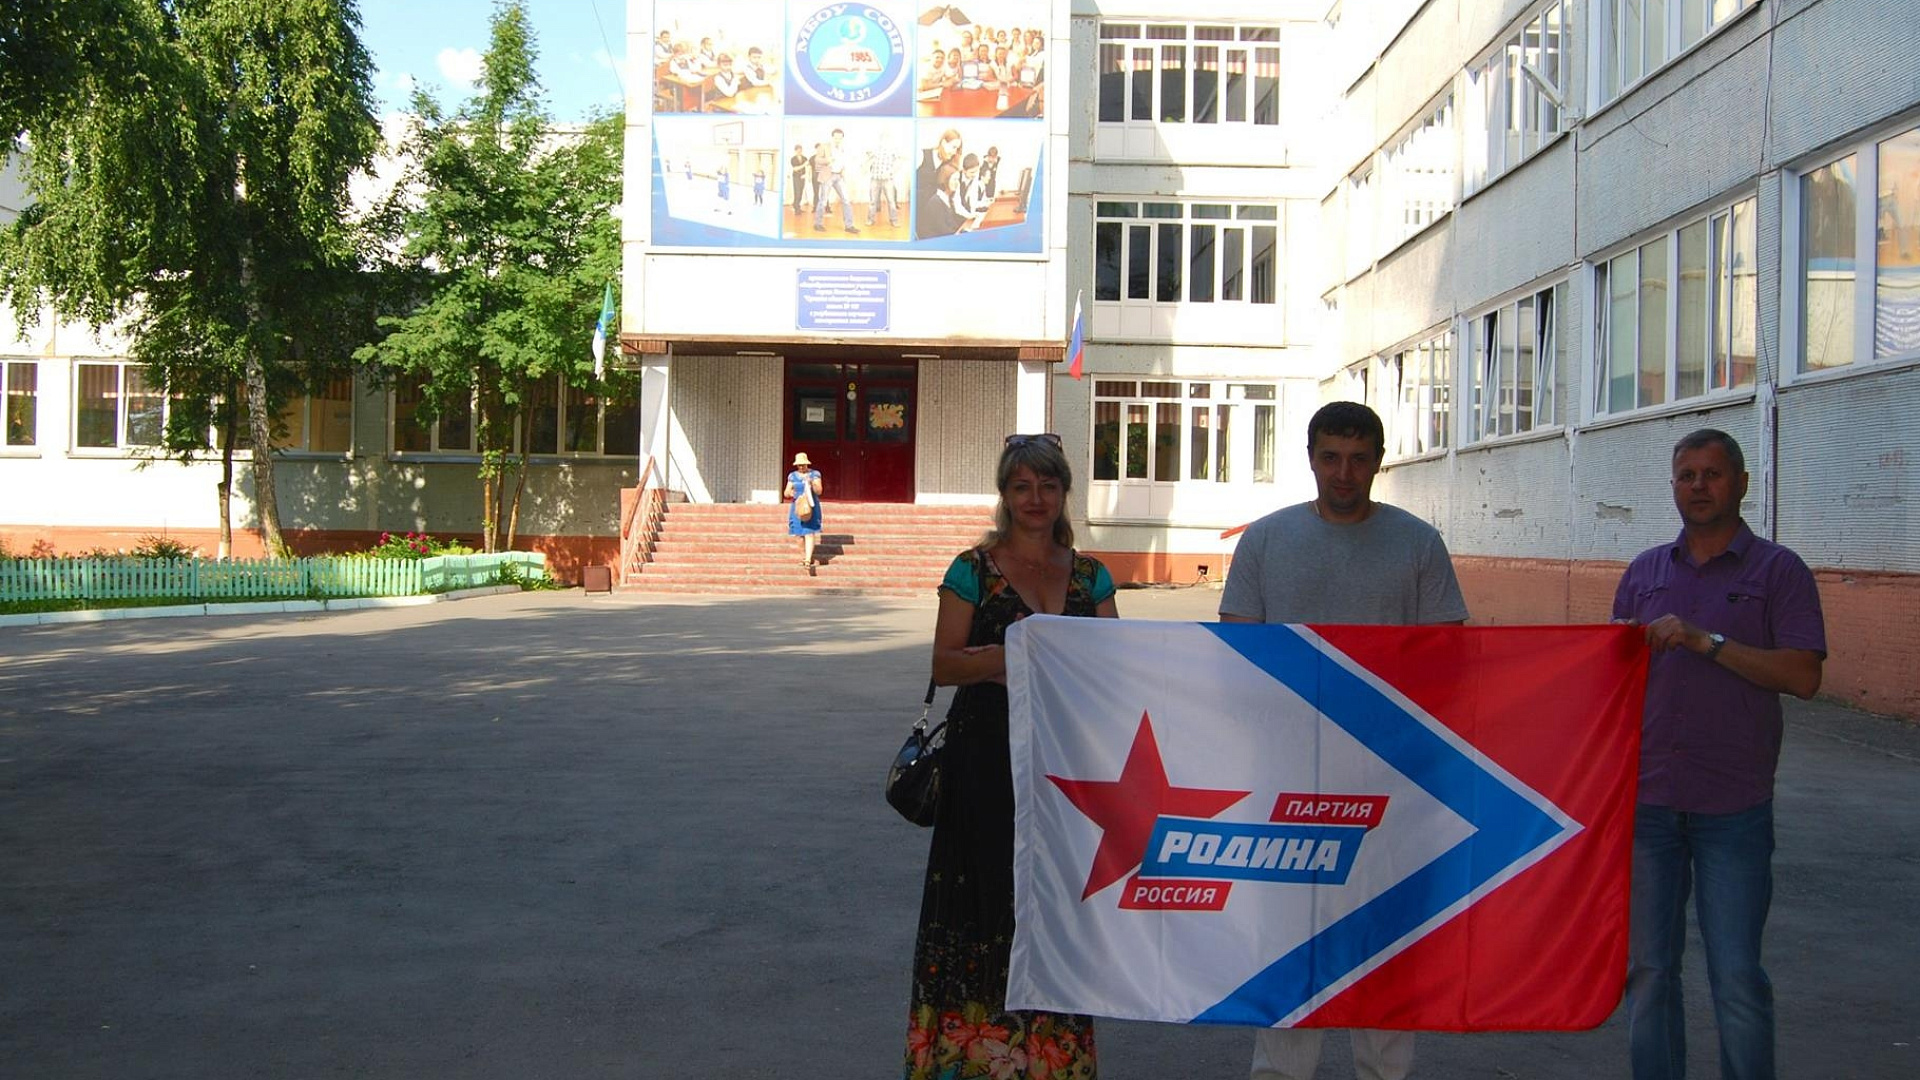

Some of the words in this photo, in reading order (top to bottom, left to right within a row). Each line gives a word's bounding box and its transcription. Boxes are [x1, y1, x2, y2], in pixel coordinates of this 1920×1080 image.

[850, 87, 871, 101] 137
[1285, 800, 1374, 819] ПАРТИЯ
[1157, 830, 1342, 872] РОДИНА
[1133, 886, 1217, 904] РОССИЯ
